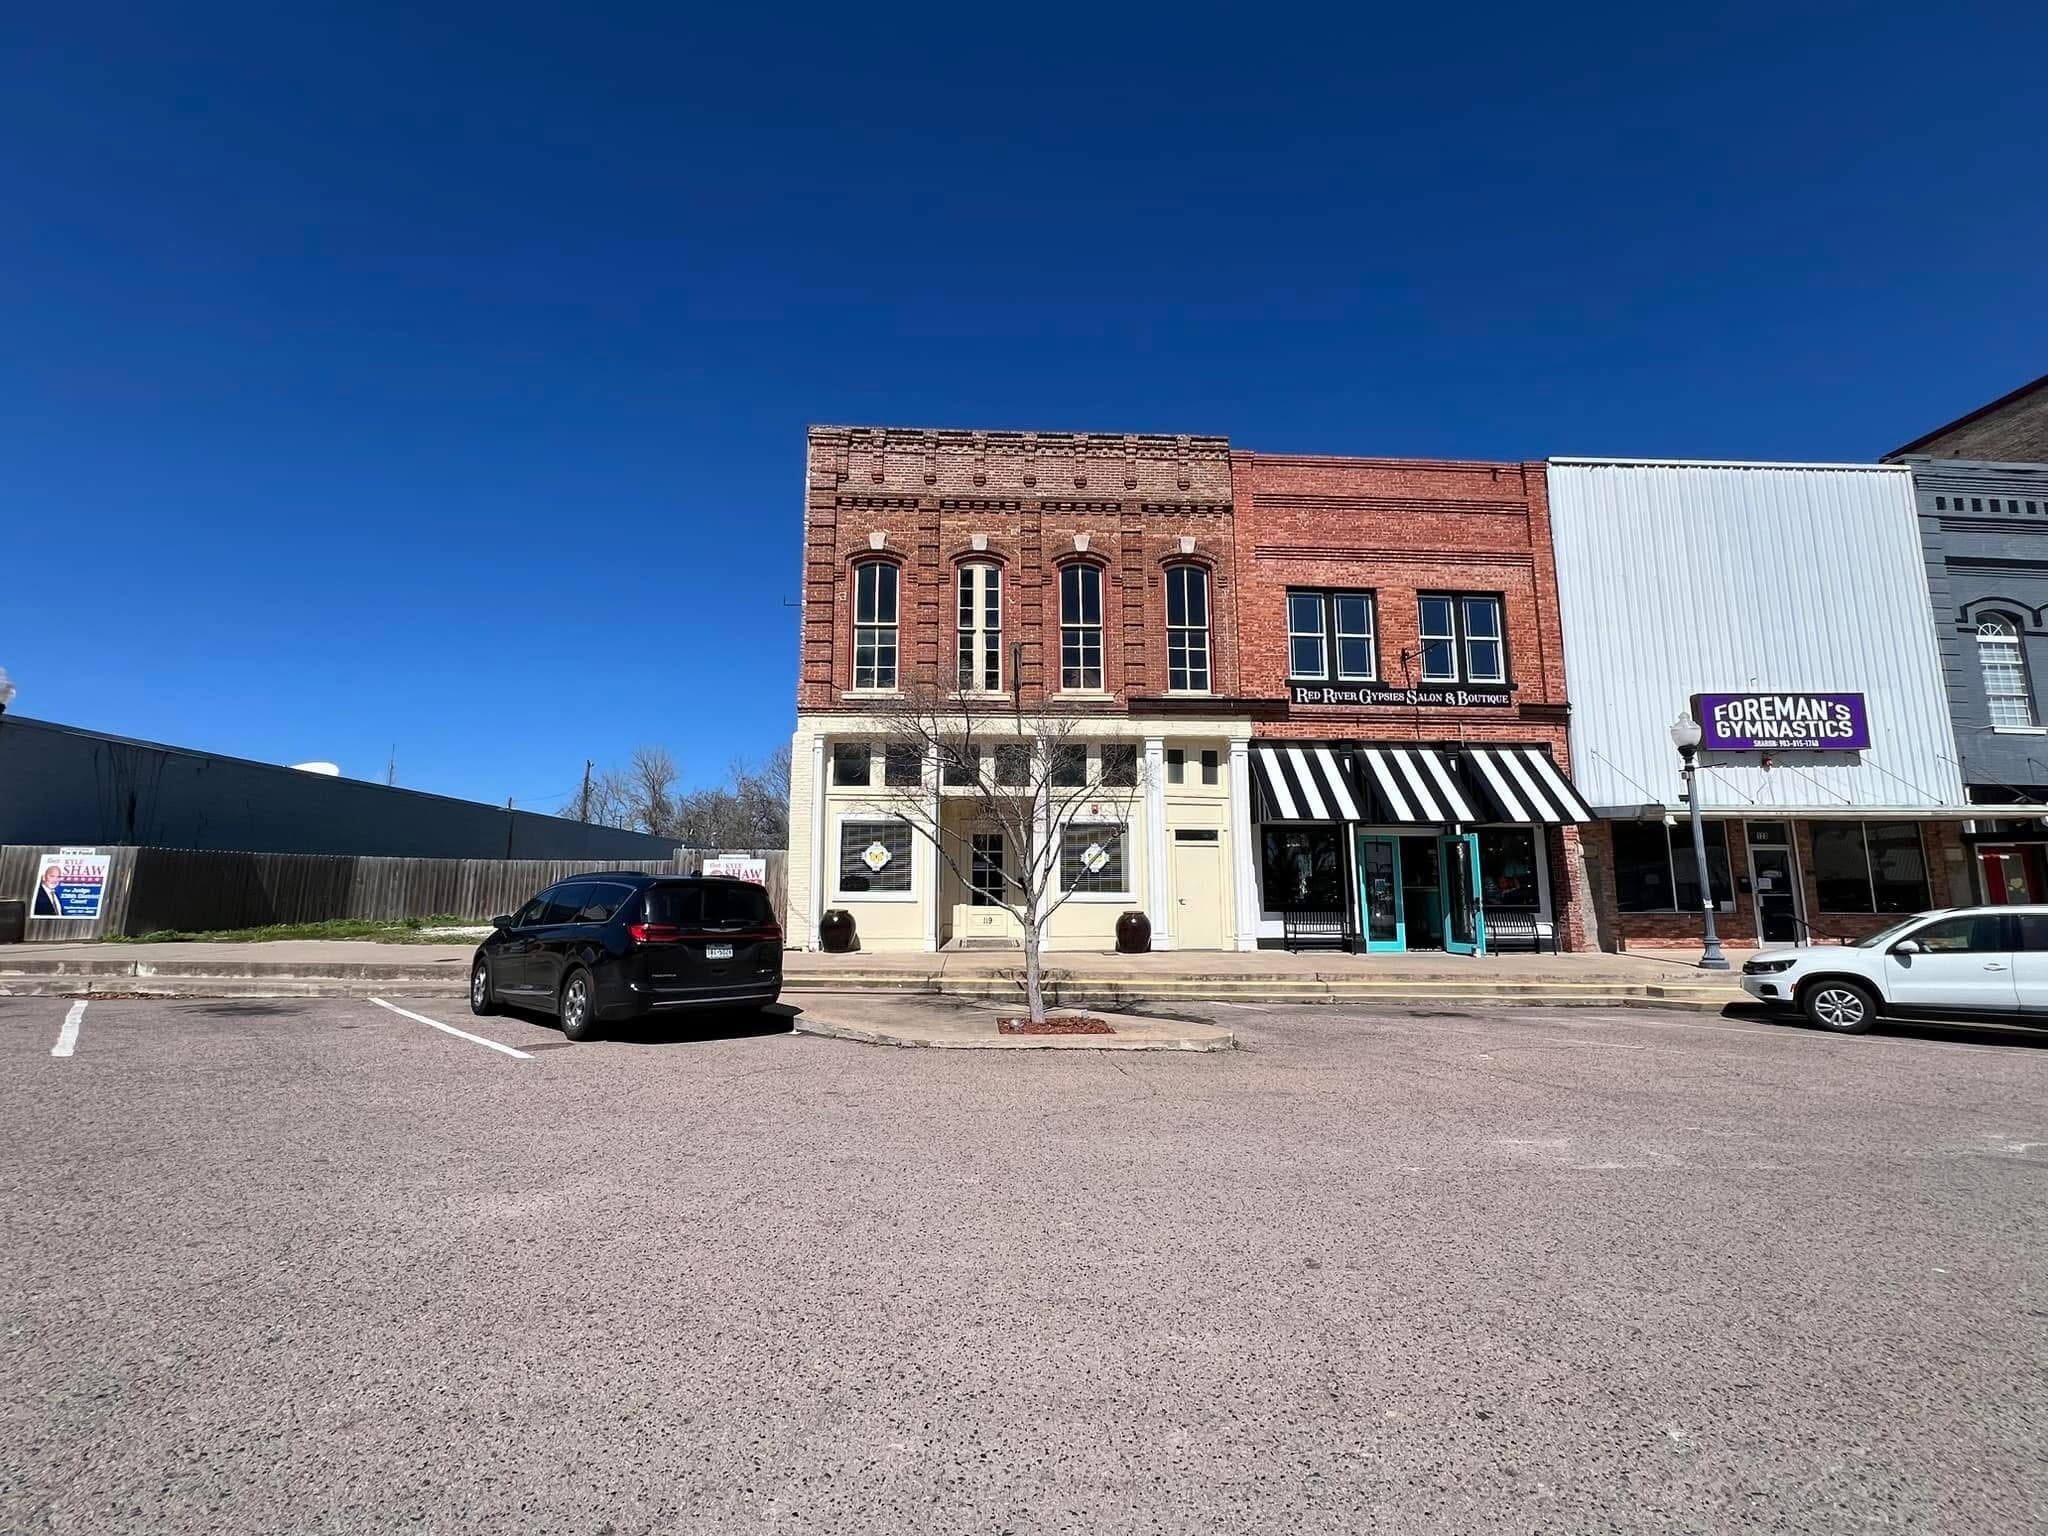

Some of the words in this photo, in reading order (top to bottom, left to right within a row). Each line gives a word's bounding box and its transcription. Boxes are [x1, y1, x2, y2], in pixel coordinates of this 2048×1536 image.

[1445, 693, 1456, 706] &
[1713, 696, 1852, 721] FOREMAN'S
[1716, 720, 1854, 738] GYMNASTICS
[62, 865, 105, 876] SHAW
[725, 868, 763, 880] SHAW
